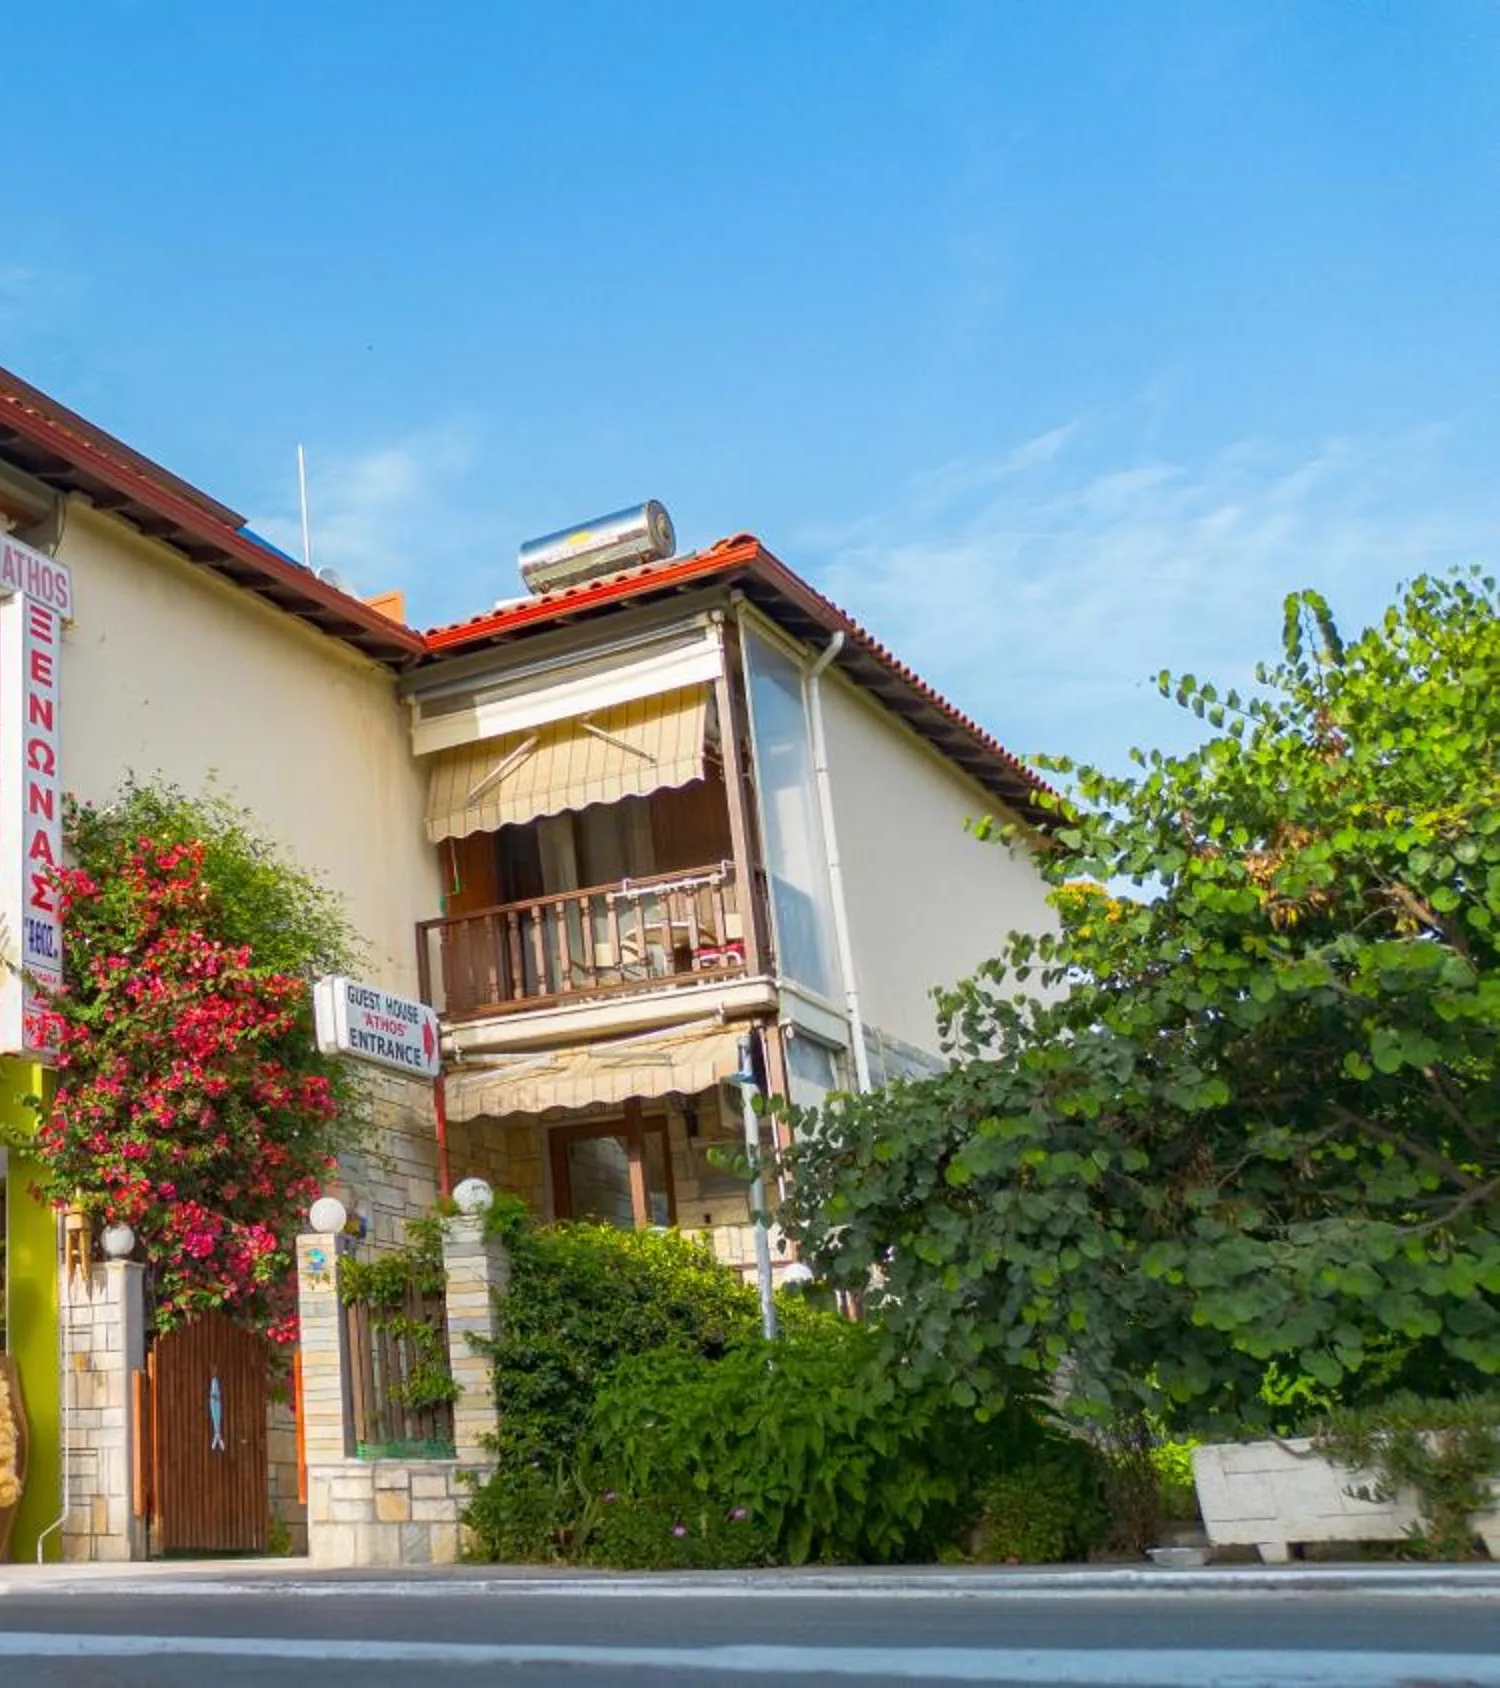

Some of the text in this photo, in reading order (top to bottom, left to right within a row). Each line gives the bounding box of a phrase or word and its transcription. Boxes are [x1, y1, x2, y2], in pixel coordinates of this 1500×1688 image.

[0, 544, 69, 609] ATHOS
[347, 985, 420, 1024] GUEST HOUSE
[349, 1027, 421, 1067] ENTRANCE
